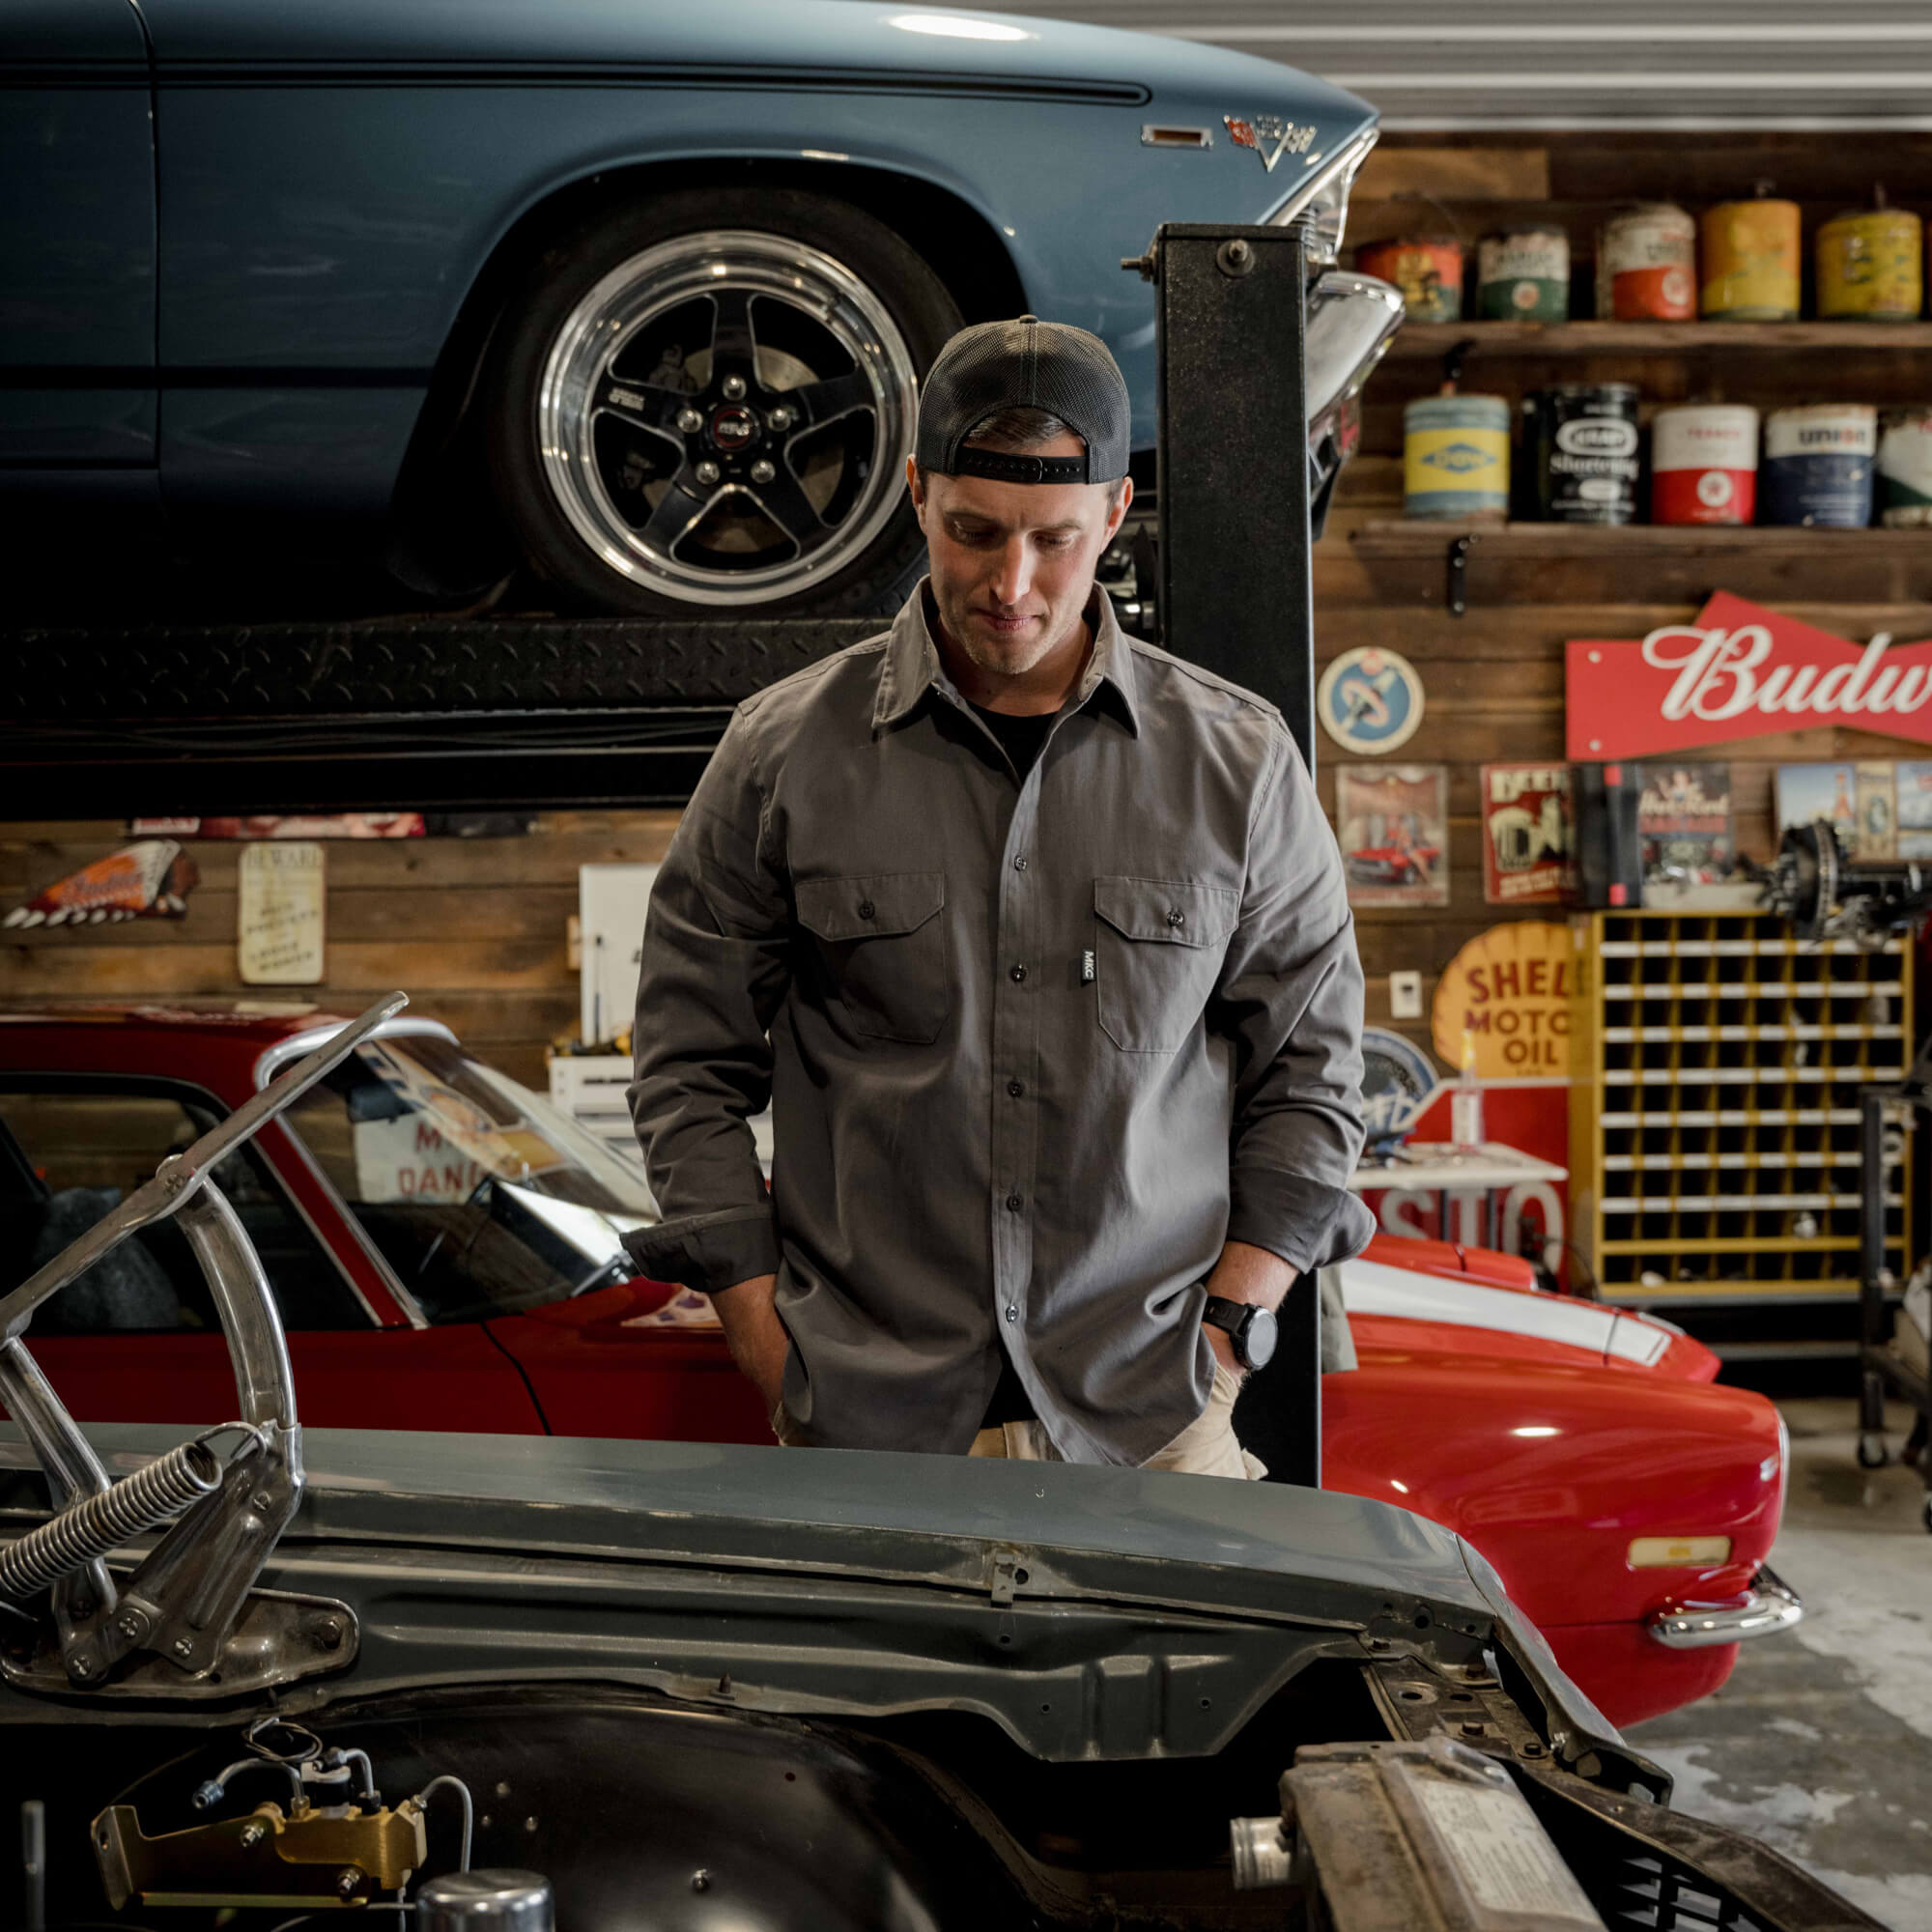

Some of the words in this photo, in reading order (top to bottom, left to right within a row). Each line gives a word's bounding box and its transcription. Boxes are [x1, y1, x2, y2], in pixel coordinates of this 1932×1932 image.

[1641, 624, 1932, 721] Budw
[1084, 951, 1094, 979] MKC
[1503, 1038, 1559, 1065] OIL
